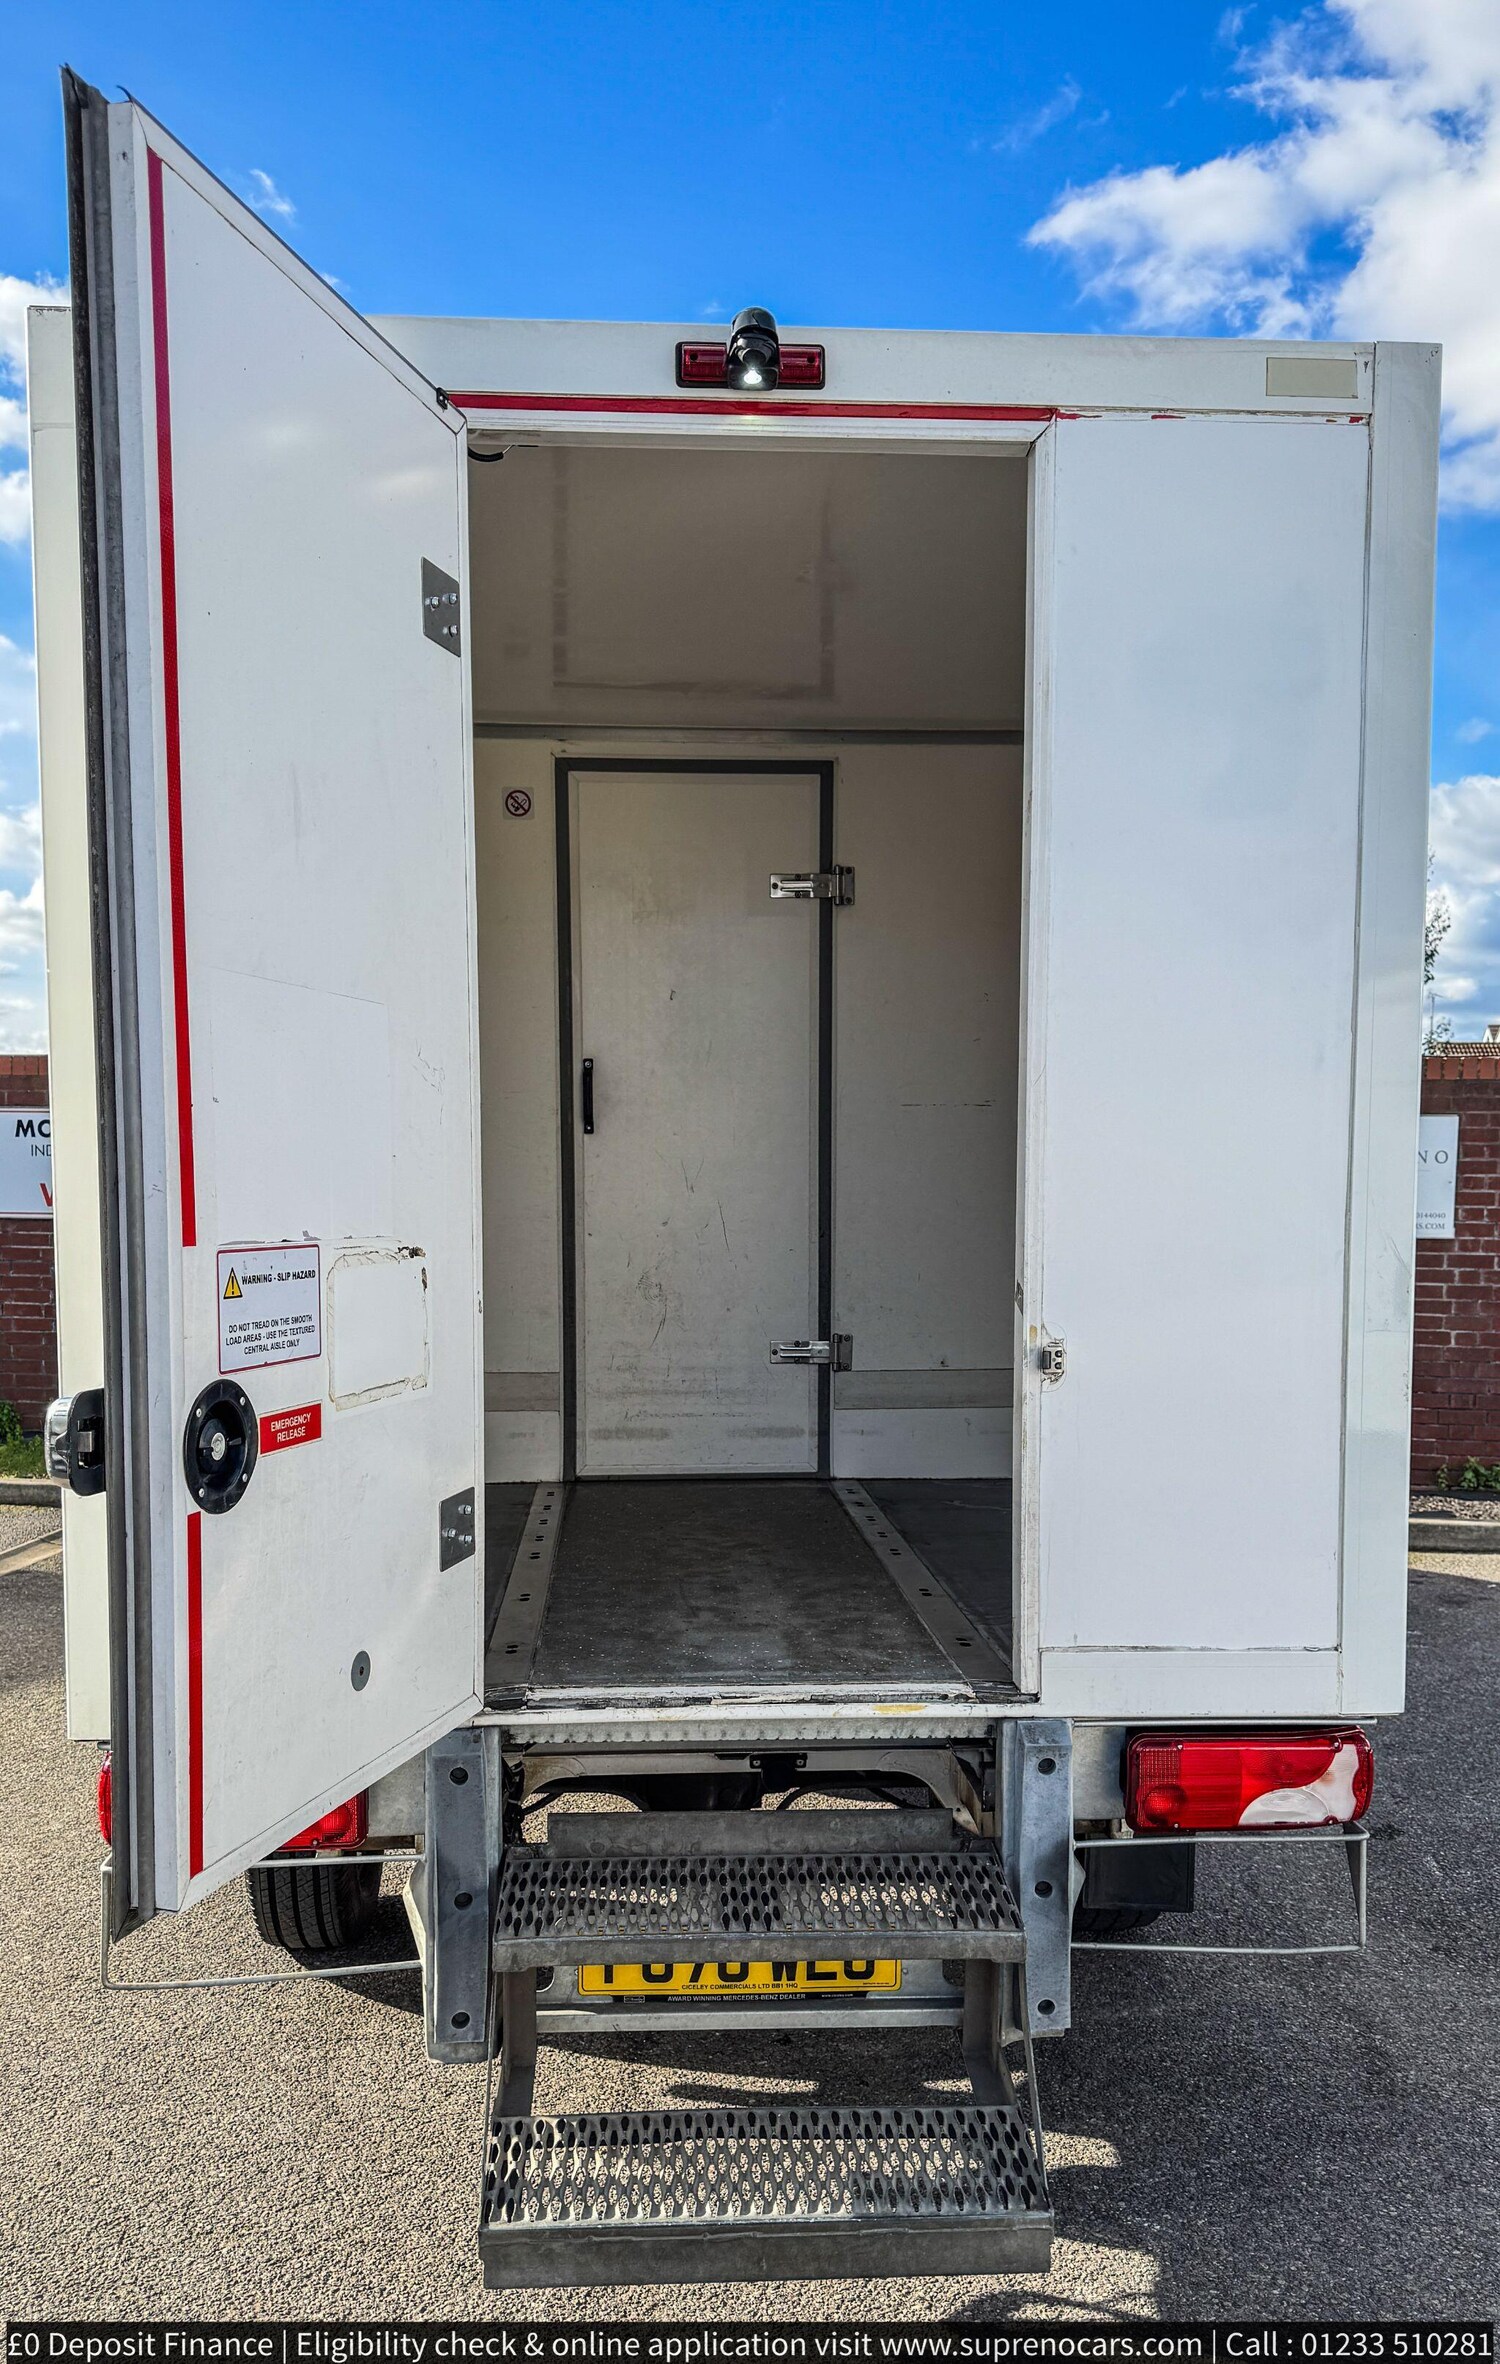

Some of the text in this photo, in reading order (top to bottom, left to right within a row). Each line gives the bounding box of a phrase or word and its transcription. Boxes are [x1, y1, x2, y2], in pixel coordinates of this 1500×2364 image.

[241, 1273, 273, 1286] WARNING
[277, 1272, 292, 1282] SLIP
[292, 1269, 316, 1281] HAZARD
[228, 1314, 313, 1334] DO NOT TREAD ON THE SMOOTH
[225, 1336, 242, 1346] LOAD
[242, 1332, 262, 1344] AREAS
[265, 1329, 277, 1340] USE
[277, 1328, 289, 1338] THE
[289, 1324, 316, 1336] TEXTURED
[243, 1338, 301, 1355] CENTRAL AISLE ONLY
[271, 1412, 311, 1432] EMERGENCY
[277, 1426, 306, 1443] RELEASE
[692, 1994, 722, 2002] WINNING
[723, 1993, 778, 2001] MERCEDES-BENZ
